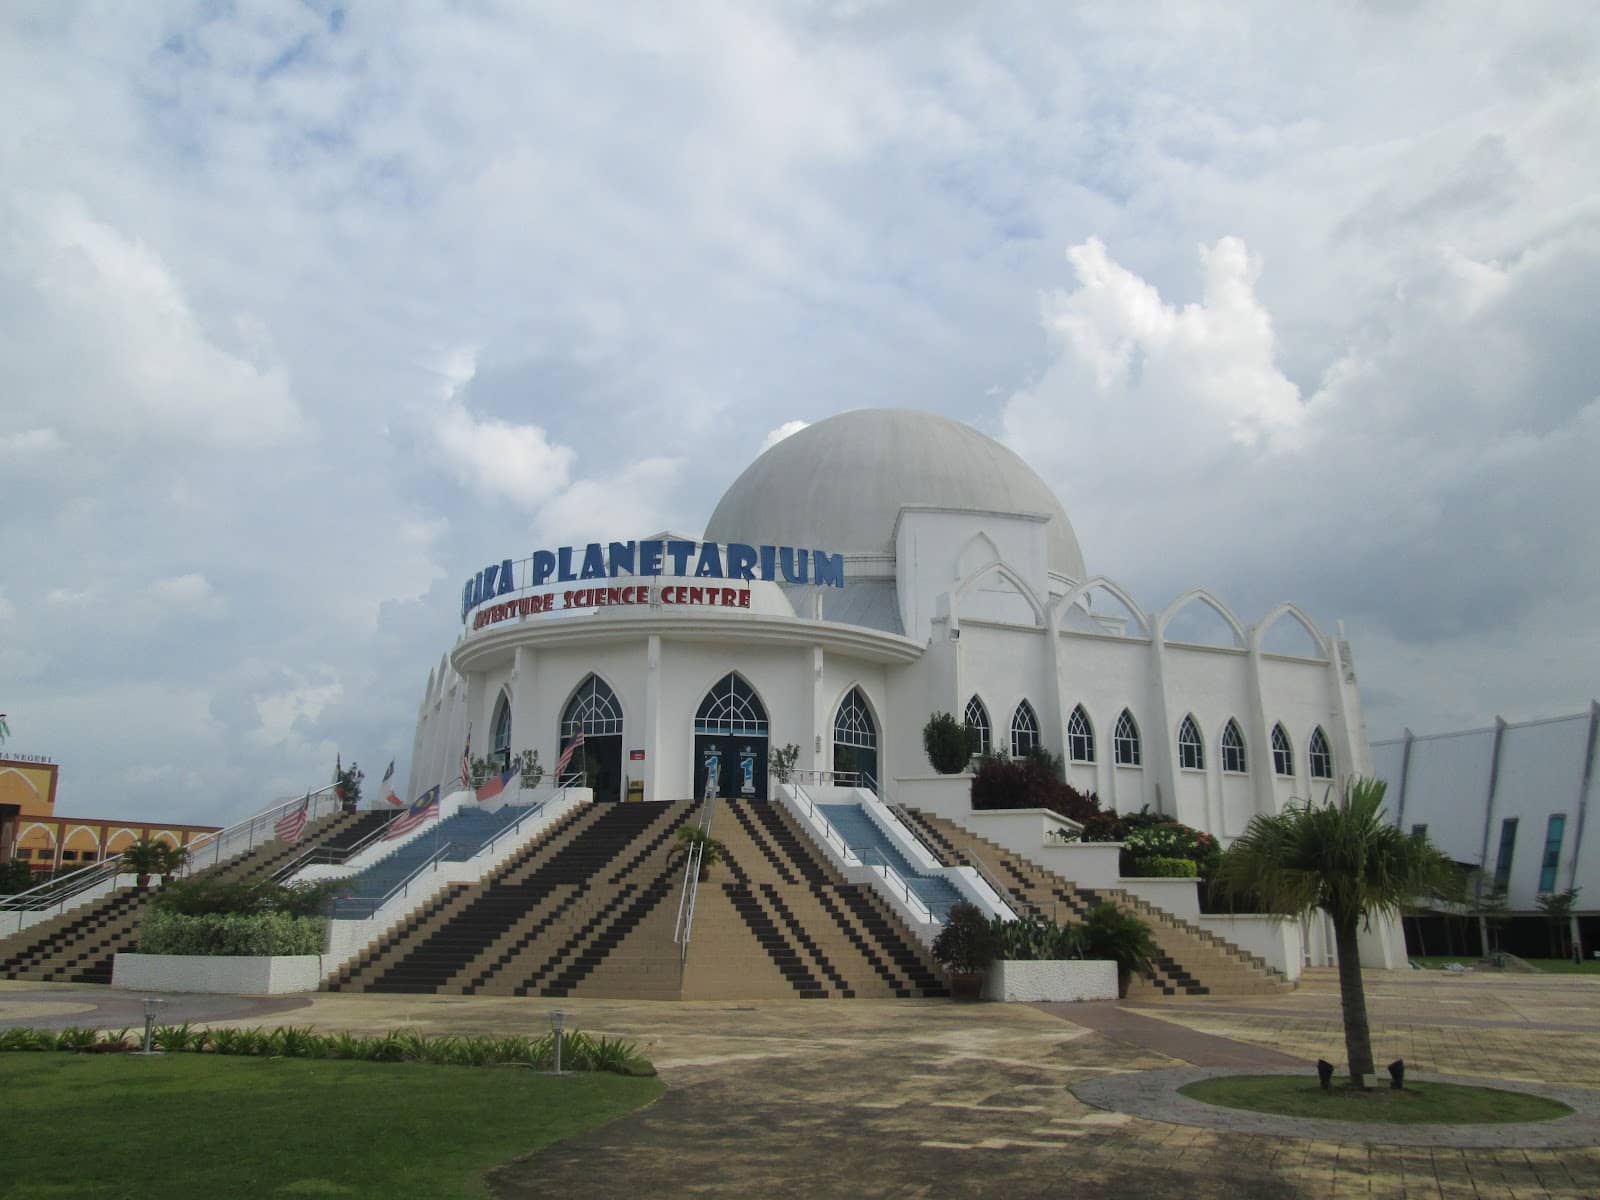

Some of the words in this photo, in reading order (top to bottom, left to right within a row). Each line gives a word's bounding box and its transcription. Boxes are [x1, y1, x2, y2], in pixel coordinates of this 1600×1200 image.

[533, 540, 844, 588] PLANETARIUM
[563, 586, 650, 608] SCIENCE
[661, 586, 751, 608] CENTRE
